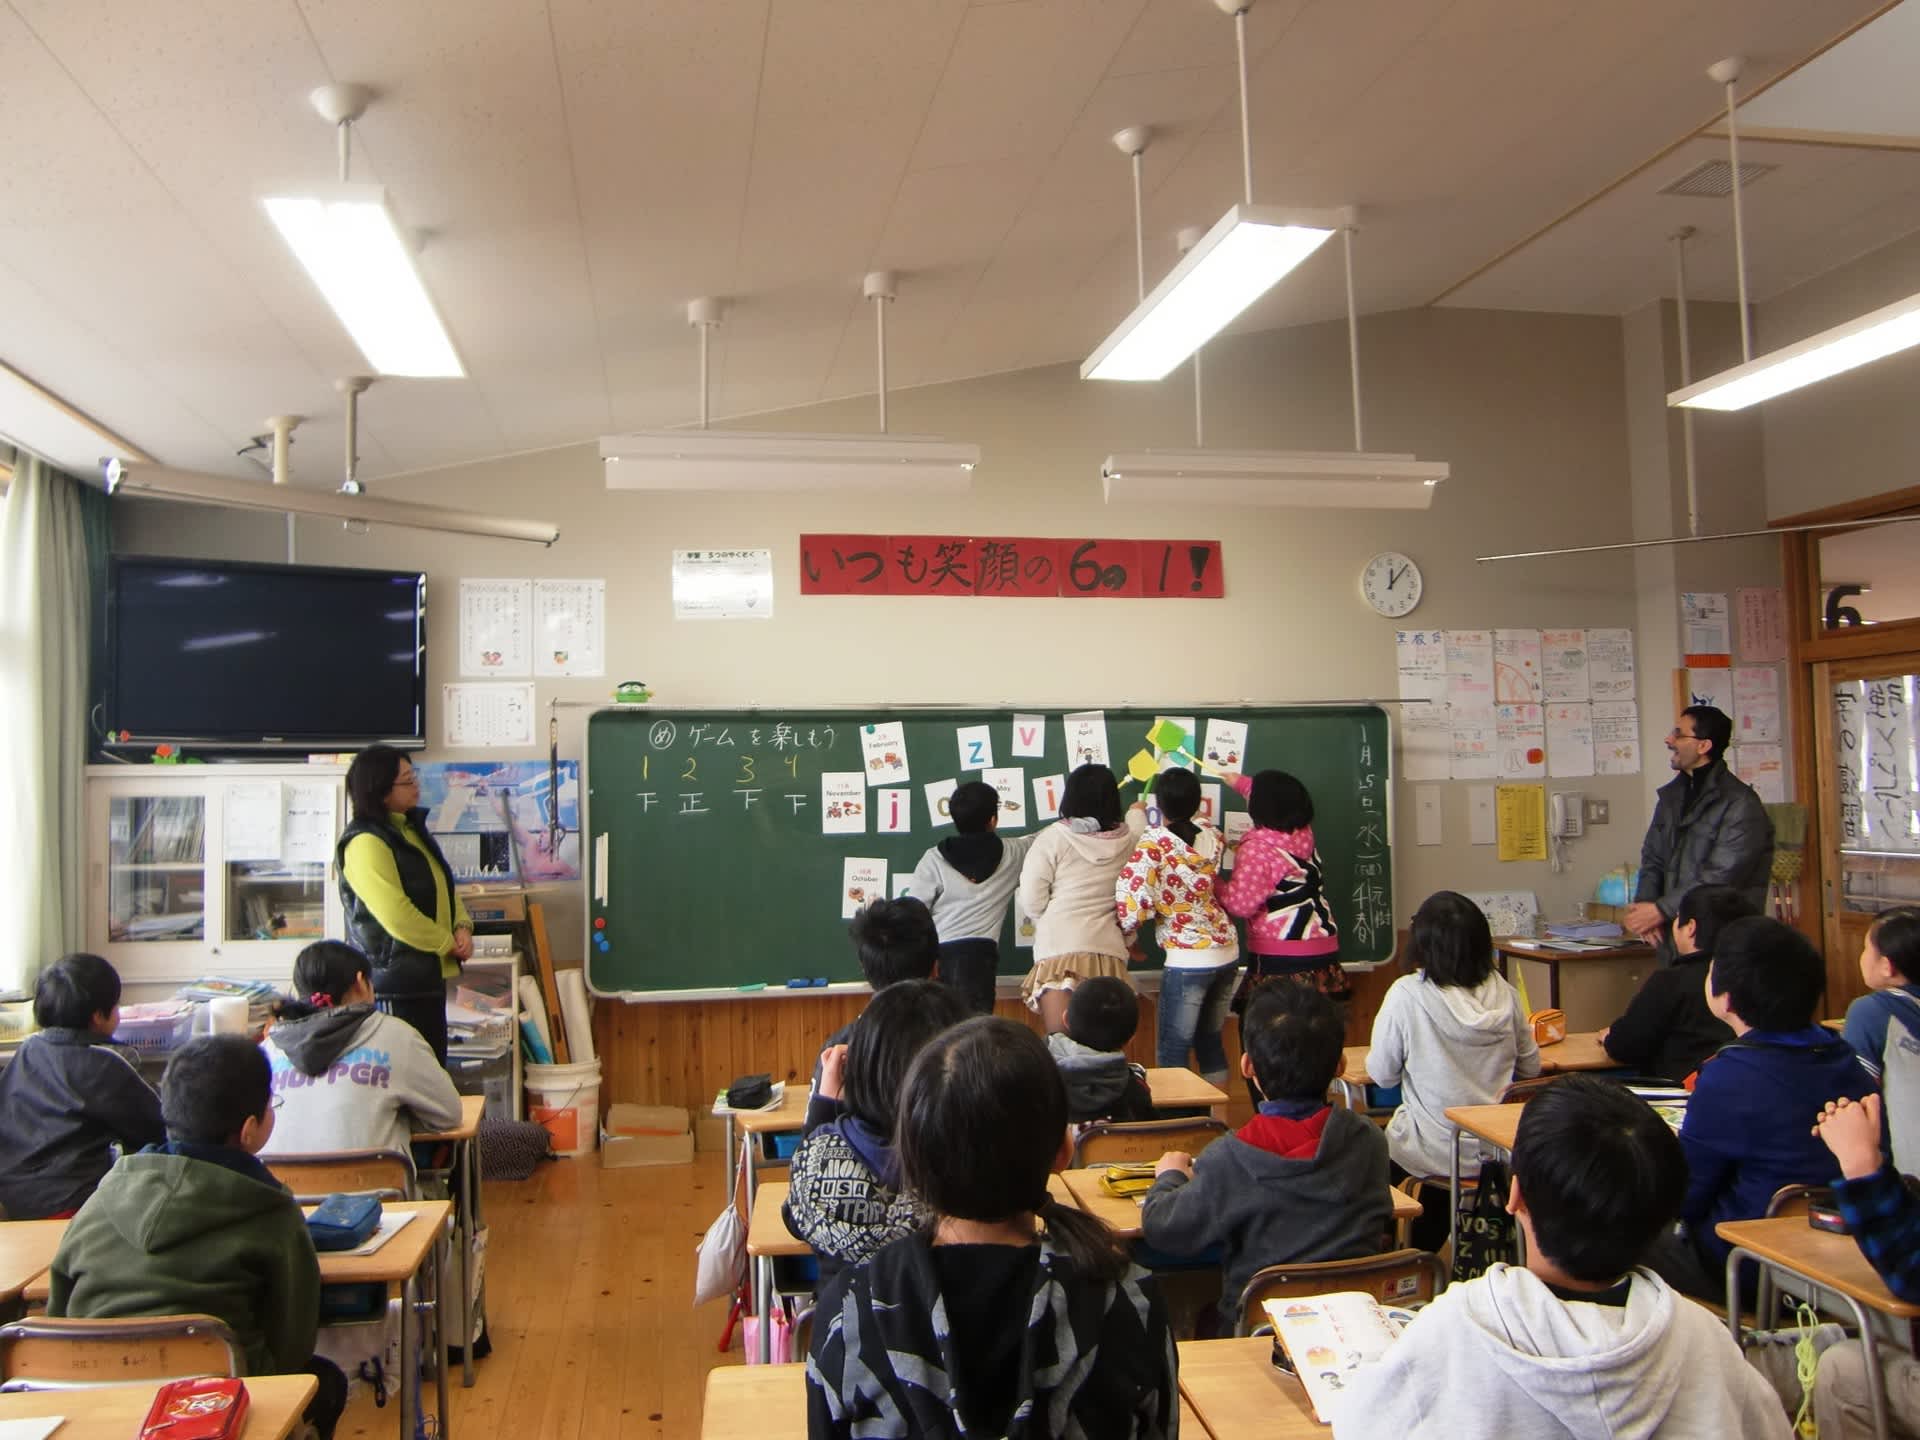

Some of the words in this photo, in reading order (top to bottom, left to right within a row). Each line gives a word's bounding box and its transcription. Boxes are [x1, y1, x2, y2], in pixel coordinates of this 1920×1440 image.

[643, 755, 649, 780] 1
[681, 757, 697, 781] 2
[735, 756, 755, 783] 3
[784, 755, 798, 779] 4
[1045, 780, 1056, 811] i
[889, 792, 898, 829] j
[821, 1180, 869, 1198] USA
[840, 1200, 886, 1223] TRIP
